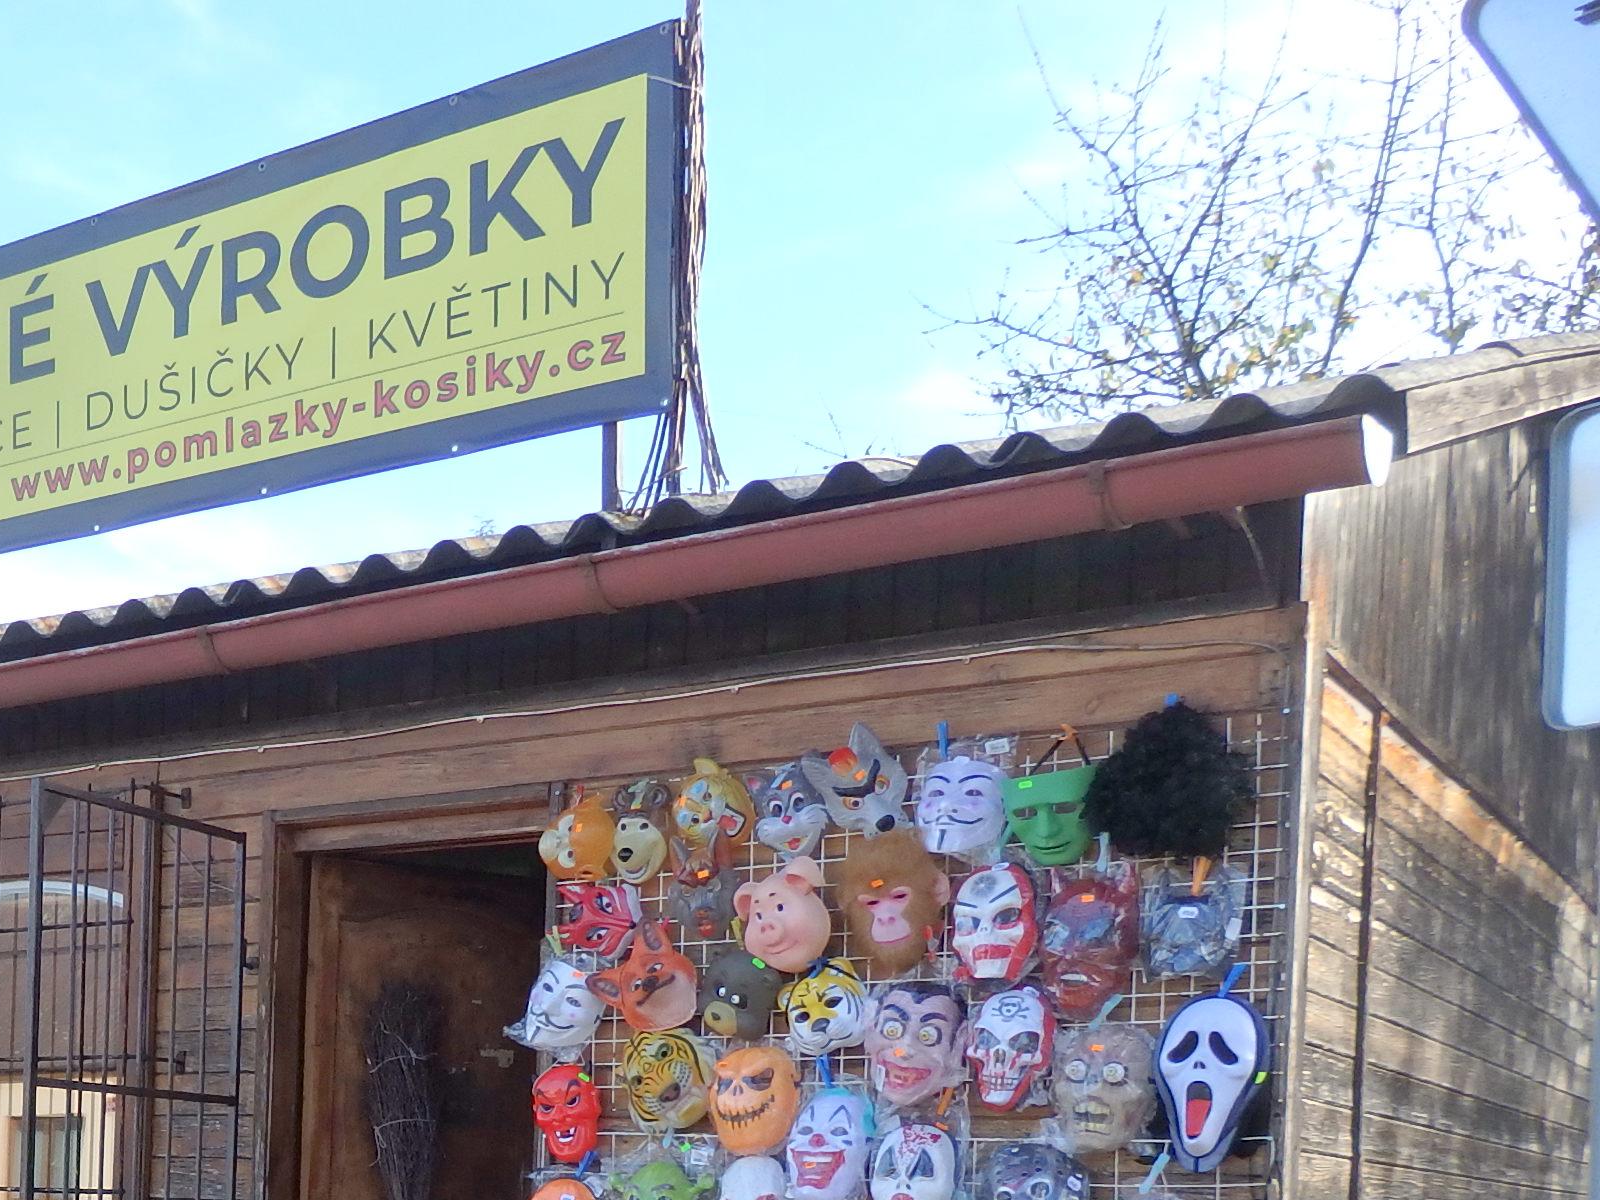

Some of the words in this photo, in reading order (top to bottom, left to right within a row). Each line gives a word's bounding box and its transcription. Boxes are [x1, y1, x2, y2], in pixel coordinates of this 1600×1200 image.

[85, 117, 625, 357] VÝROBKY
[11, 331, 625, 501] www.pomlazky-kosiky.cz
[86, 337, 304, 431] DUŠIČKY
[368, 251, 625, 359] KVĚTINY
